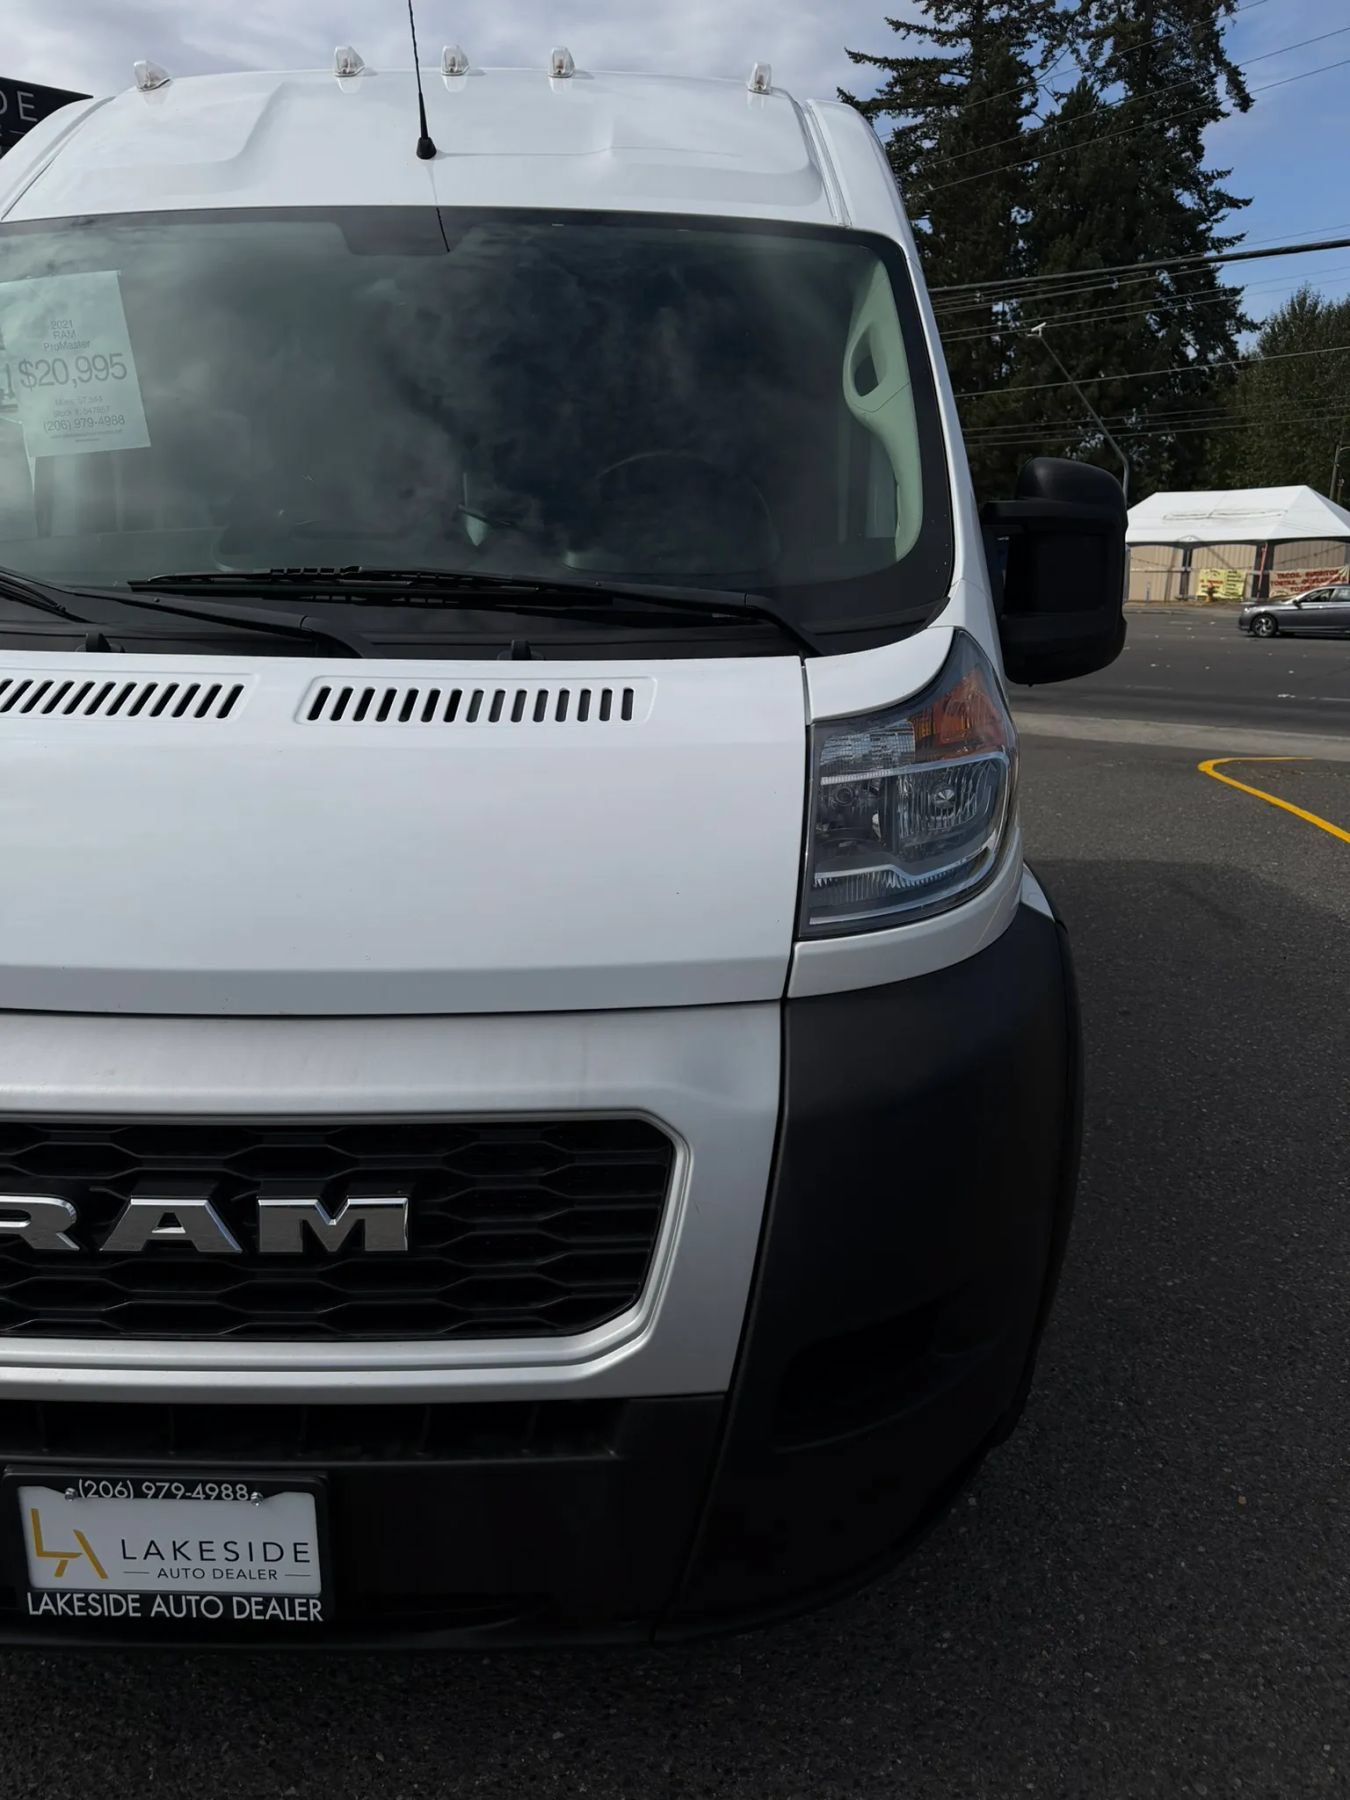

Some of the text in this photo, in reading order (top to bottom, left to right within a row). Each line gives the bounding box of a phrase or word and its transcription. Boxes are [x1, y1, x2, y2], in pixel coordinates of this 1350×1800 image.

[50, 319, 73, 330] 2021
[53, 329, 77, 341] RAM
[43, 339, 91, 352] ProMaster
[18, 353, 128, 391] $20,995
[43, 414, 126, 433] (206) 979-4988
[0, 1194, 410, 1253] RAM
[78, 1479, 250, 1502] (206) 979-4988
[121, 1538, 311, 1564] LAKESIDE
[156, 1567, 278, 1581] AUTO DEALER
[27, 1592, 324, 1622] LAKESIDE AUTO DEALER
